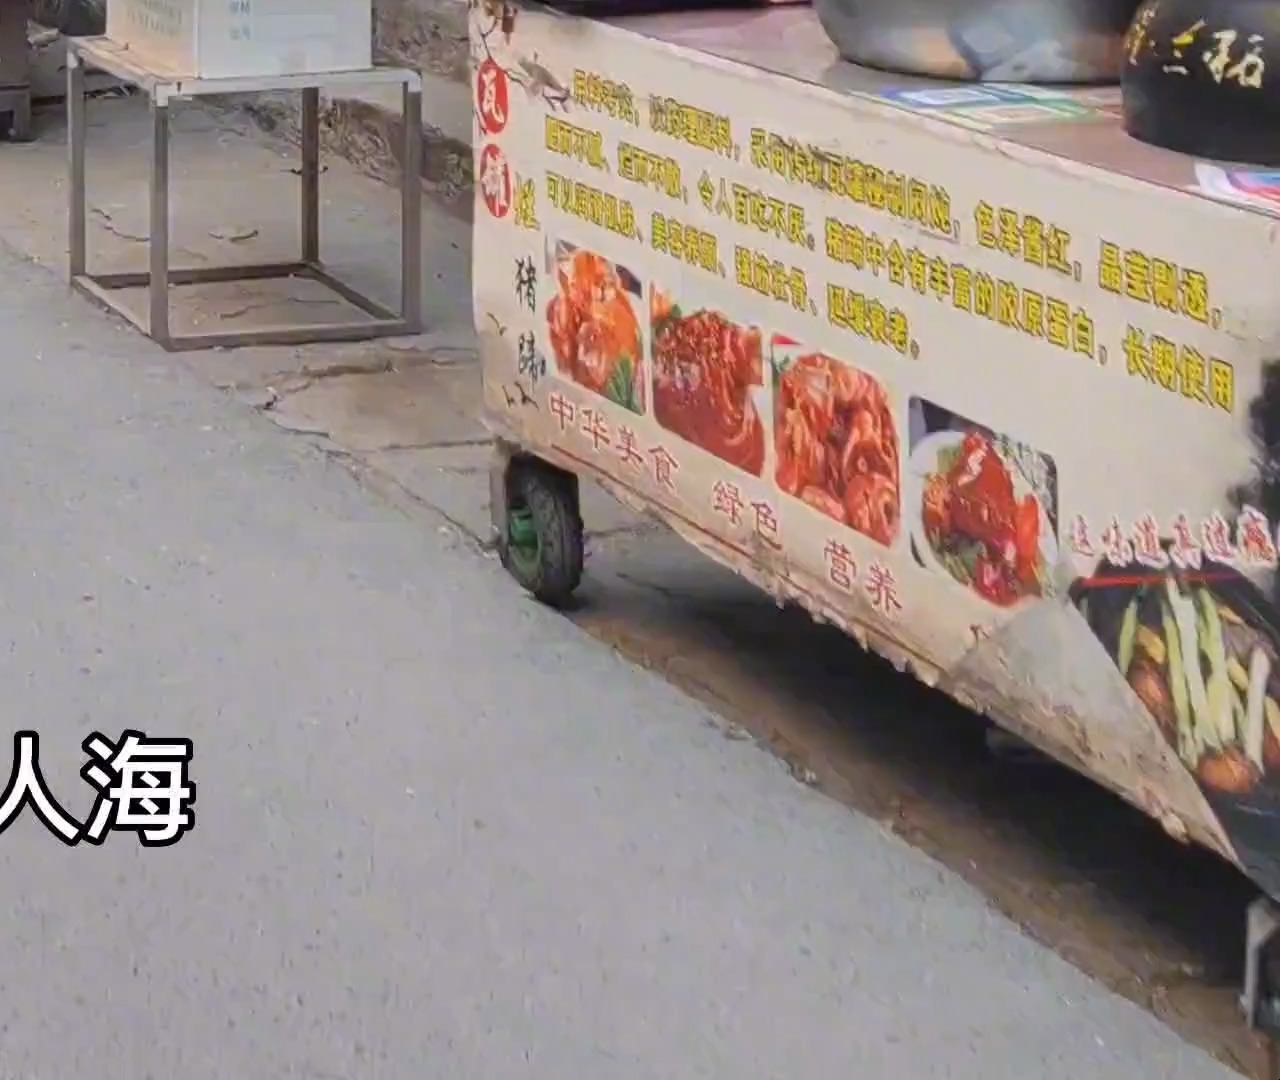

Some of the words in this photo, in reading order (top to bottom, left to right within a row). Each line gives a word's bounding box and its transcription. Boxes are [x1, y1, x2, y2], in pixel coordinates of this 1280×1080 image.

[549, 392, 679, 490] 中华美食
[713, 480, 783, 552] 绿色
[824, 540, 903, 618] 营养
